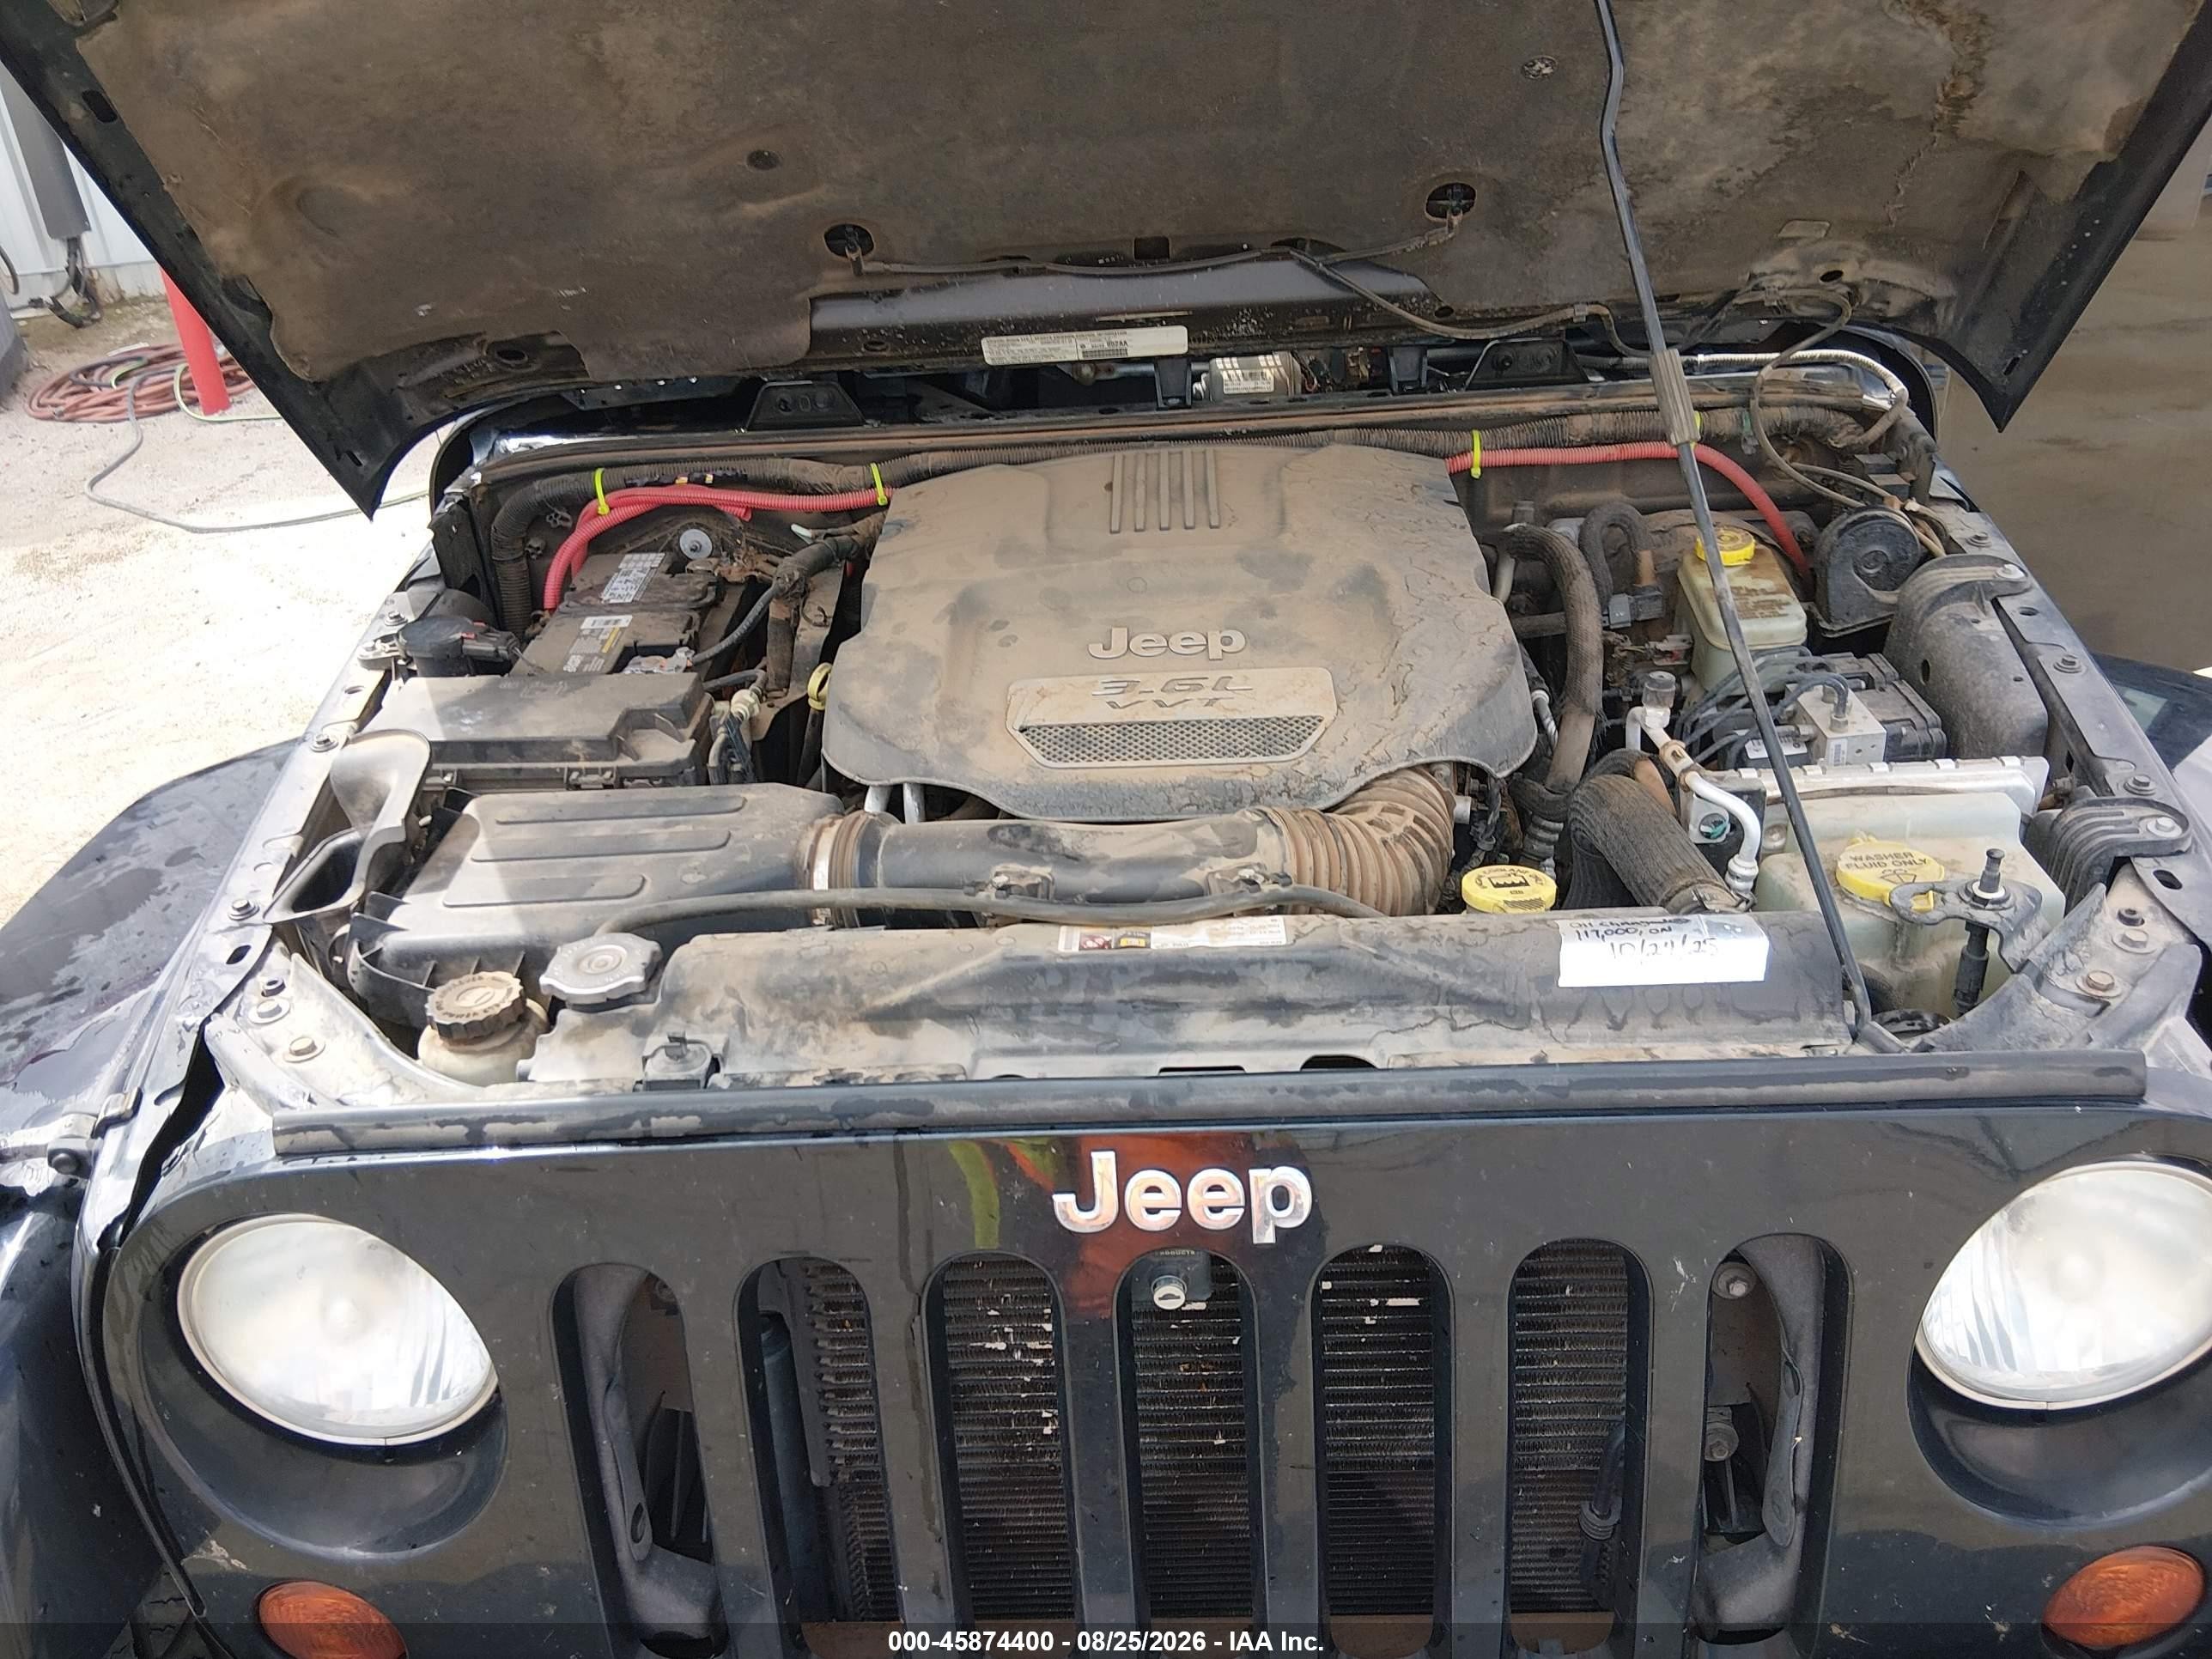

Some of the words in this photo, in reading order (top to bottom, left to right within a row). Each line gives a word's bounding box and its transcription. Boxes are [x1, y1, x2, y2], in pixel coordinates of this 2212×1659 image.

[1088, 628, 1246, 660] Jeep
[1091, 676, 1253, 696] 3.6L
[1845, 860, 1887, 870] FLUID
[1892, 858, 1928, 867] ONLY
[1851, 852, 1913, 861] WASHER
[1051, 1151, 1313, 1244] Jeep
